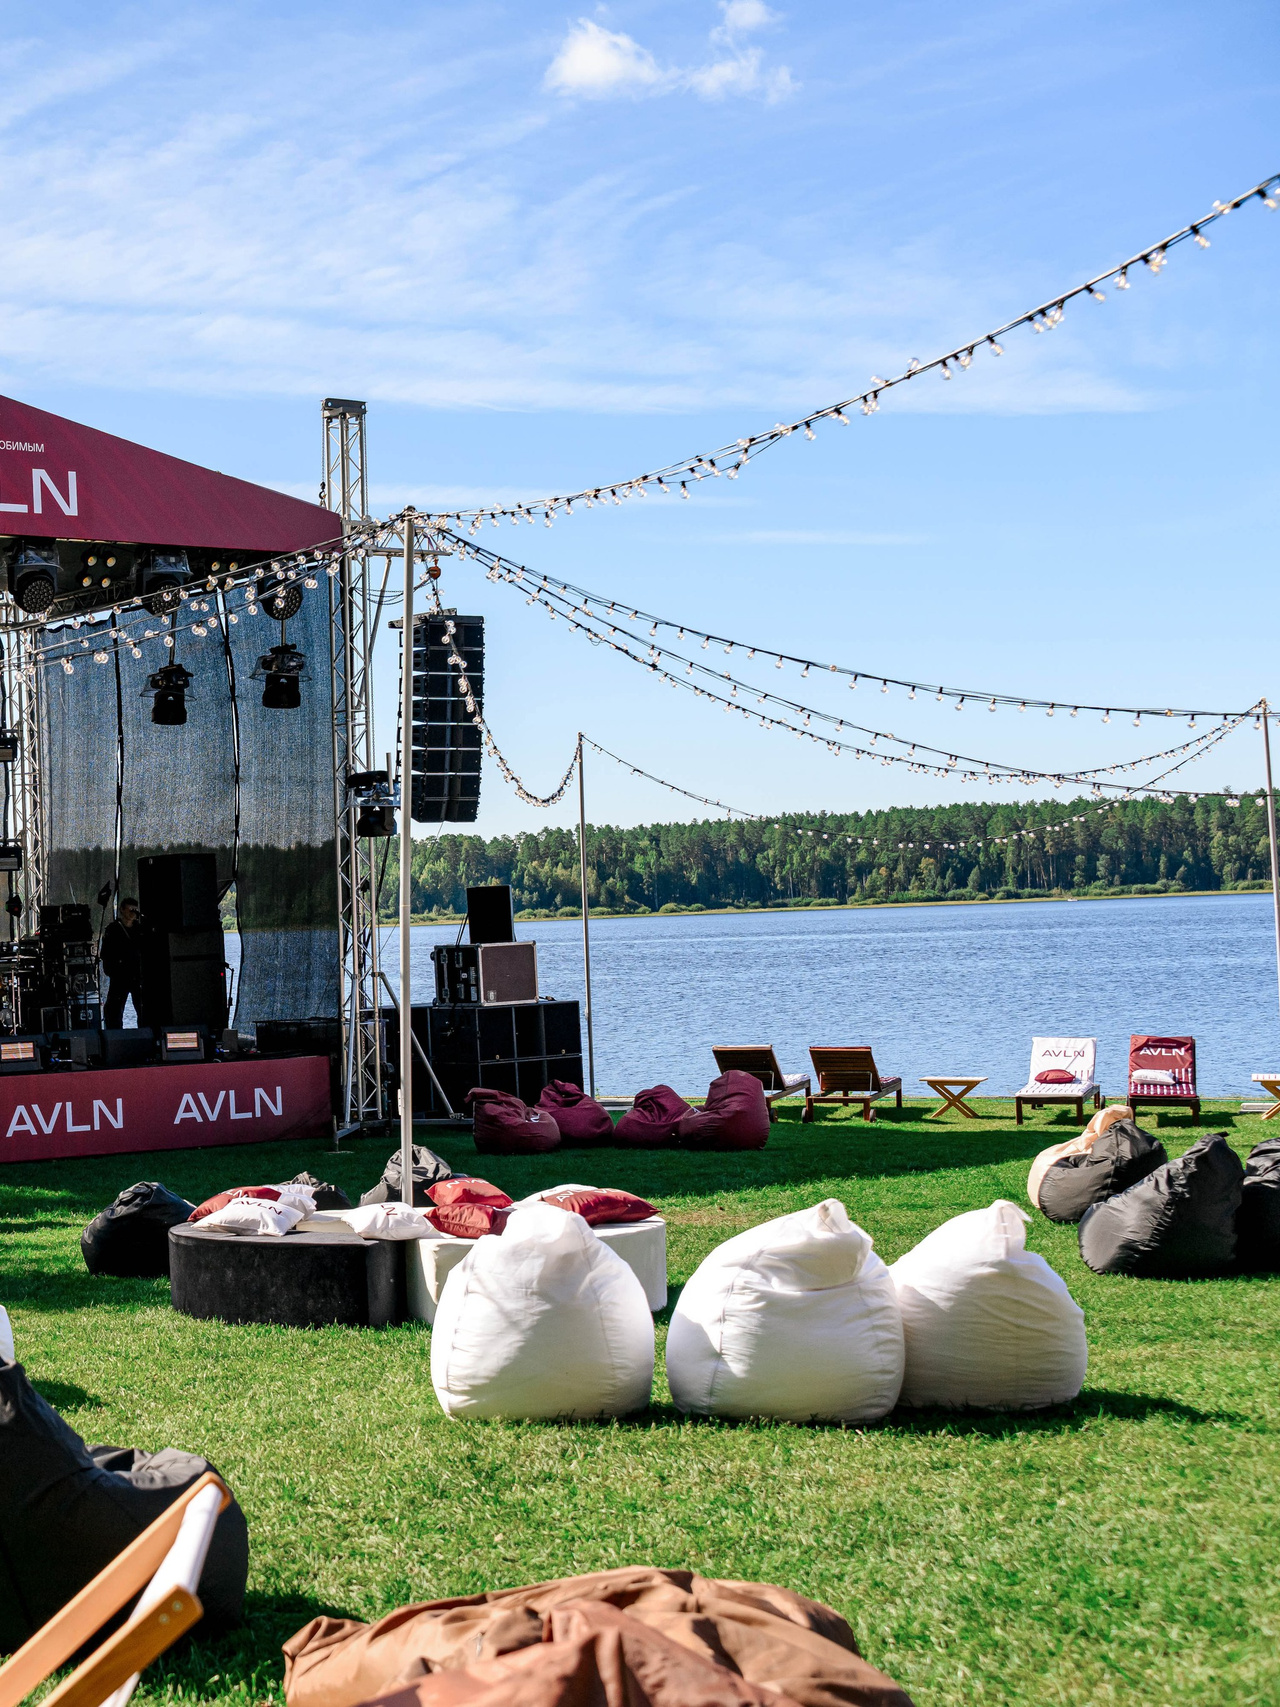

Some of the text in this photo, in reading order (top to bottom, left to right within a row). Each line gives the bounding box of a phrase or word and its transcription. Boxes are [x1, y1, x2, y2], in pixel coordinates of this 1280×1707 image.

[1042, 1049, 1085, 1057] AVLN
[1139, 1047, 1185, 1056] AVLN
[174, 1086, 283, 1124] AVLN
[6, 1098, 123, 1137] AVLN
[233, 1201, 283, 1216] AVLN
